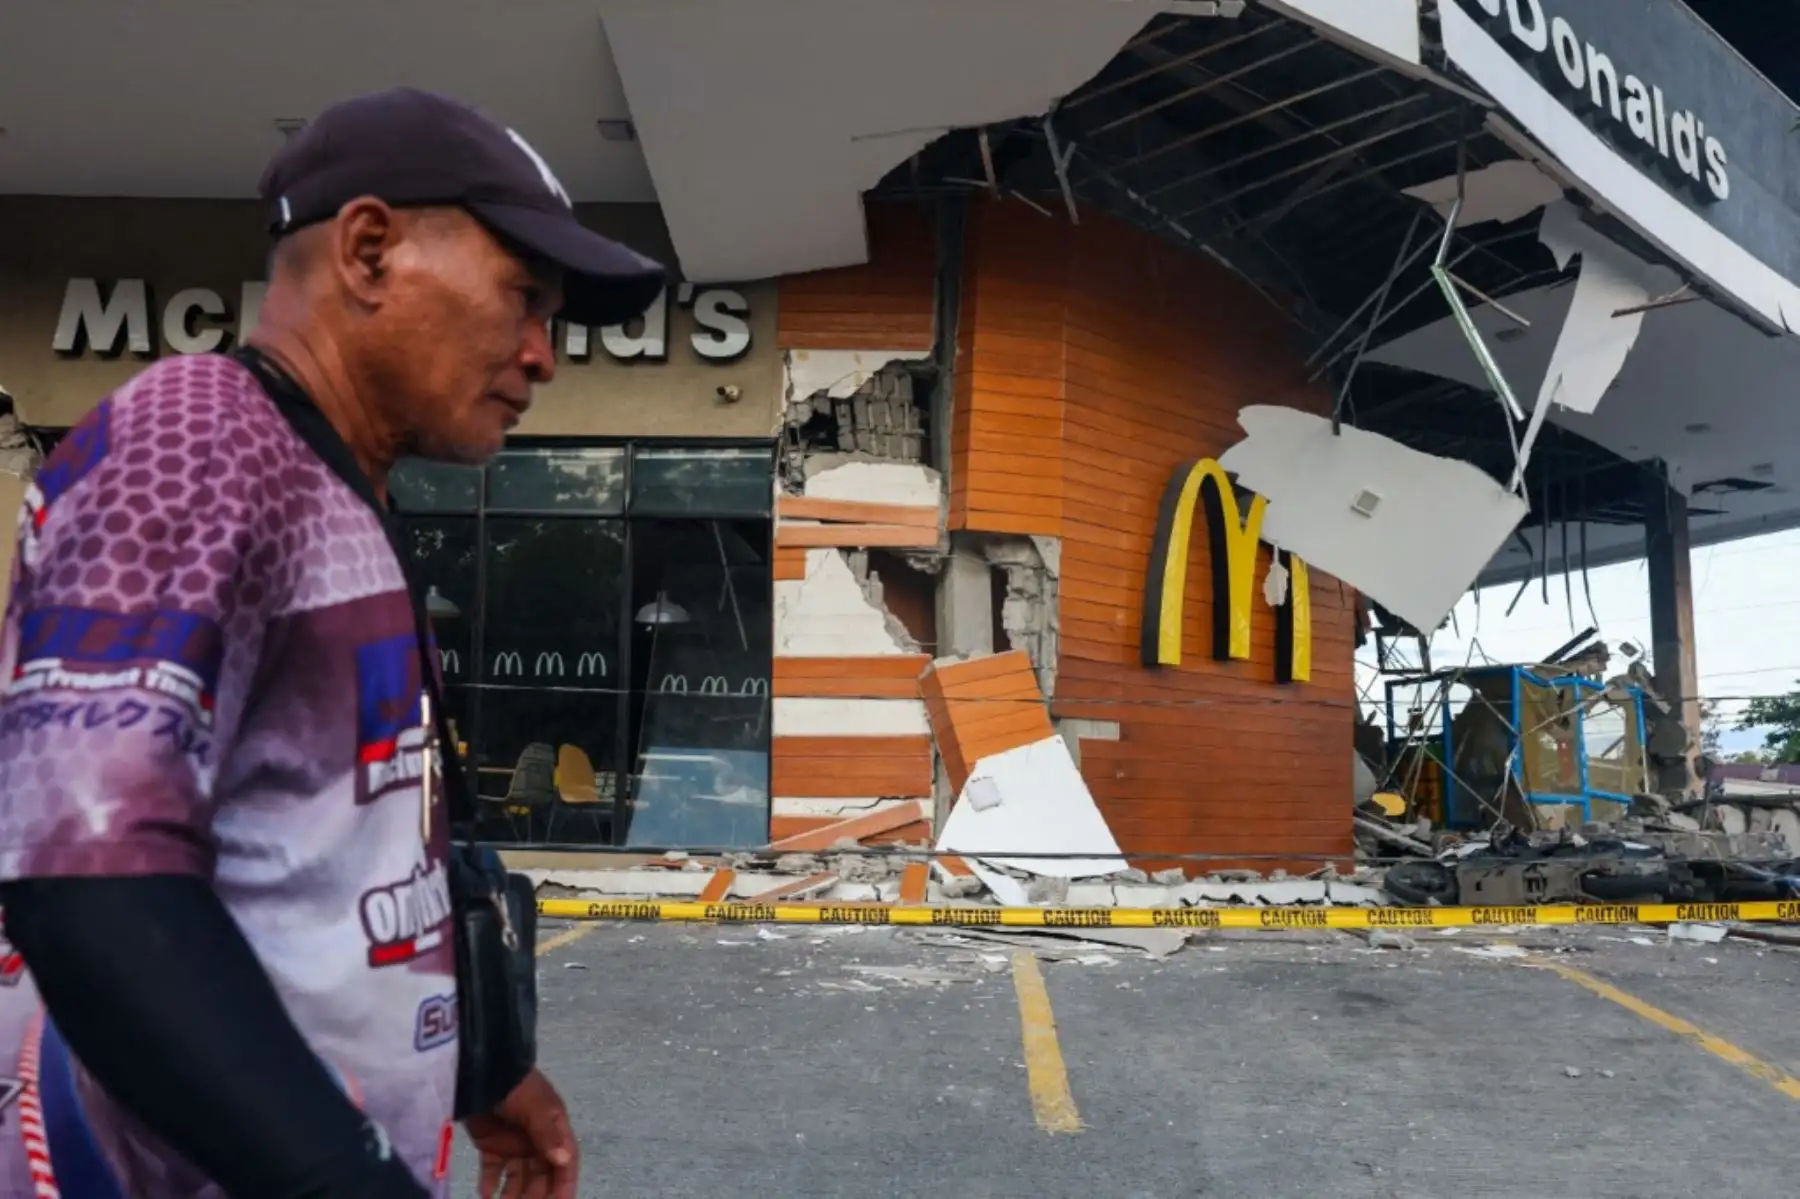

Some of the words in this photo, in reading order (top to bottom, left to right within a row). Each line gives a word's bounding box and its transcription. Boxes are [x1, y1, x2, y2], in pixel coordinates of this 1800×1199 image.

[588, 903, 661, 919] CAUTION
[703, 905, 777, 921] CAUTION
[819, 907, 890, 923] CAUTION
[932, 908, 1001, 924] CAUTION
[1043, 908, 1112, 925] CAUTION
[1152, 909, 1221, 926] CAUTION
[1260, 909, 1328, 926] CAUTION
[1366, 908, 1433, 925] CAUTION
[1471, 908, 1536, 924] CAUTION
[1575, 906, 1639, 922] CAUTION
[1676, 904, 1739, 921] CAUTION
